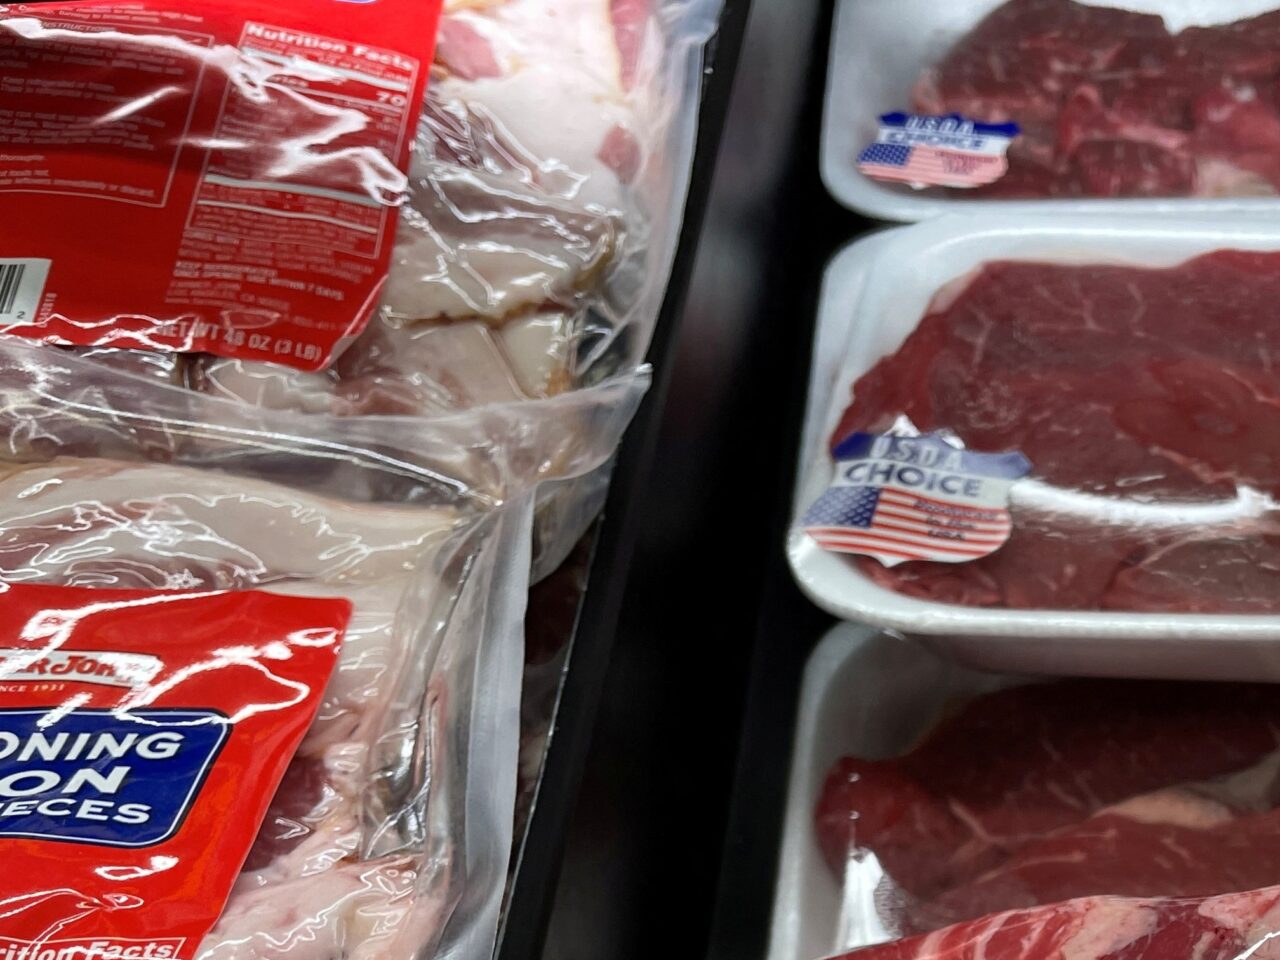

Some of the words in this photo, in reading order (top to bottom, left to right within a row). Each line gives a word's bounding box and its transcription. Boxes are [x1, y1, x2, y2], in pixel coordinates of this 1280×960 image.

[246, 24, 348, 53] Nutrition
[353, 45, 413, 71] Facts
[845, 462, 982, 498] CHOICE
[0, 732, 185, 762] ONING
[0, 766, 131, 797] ON
